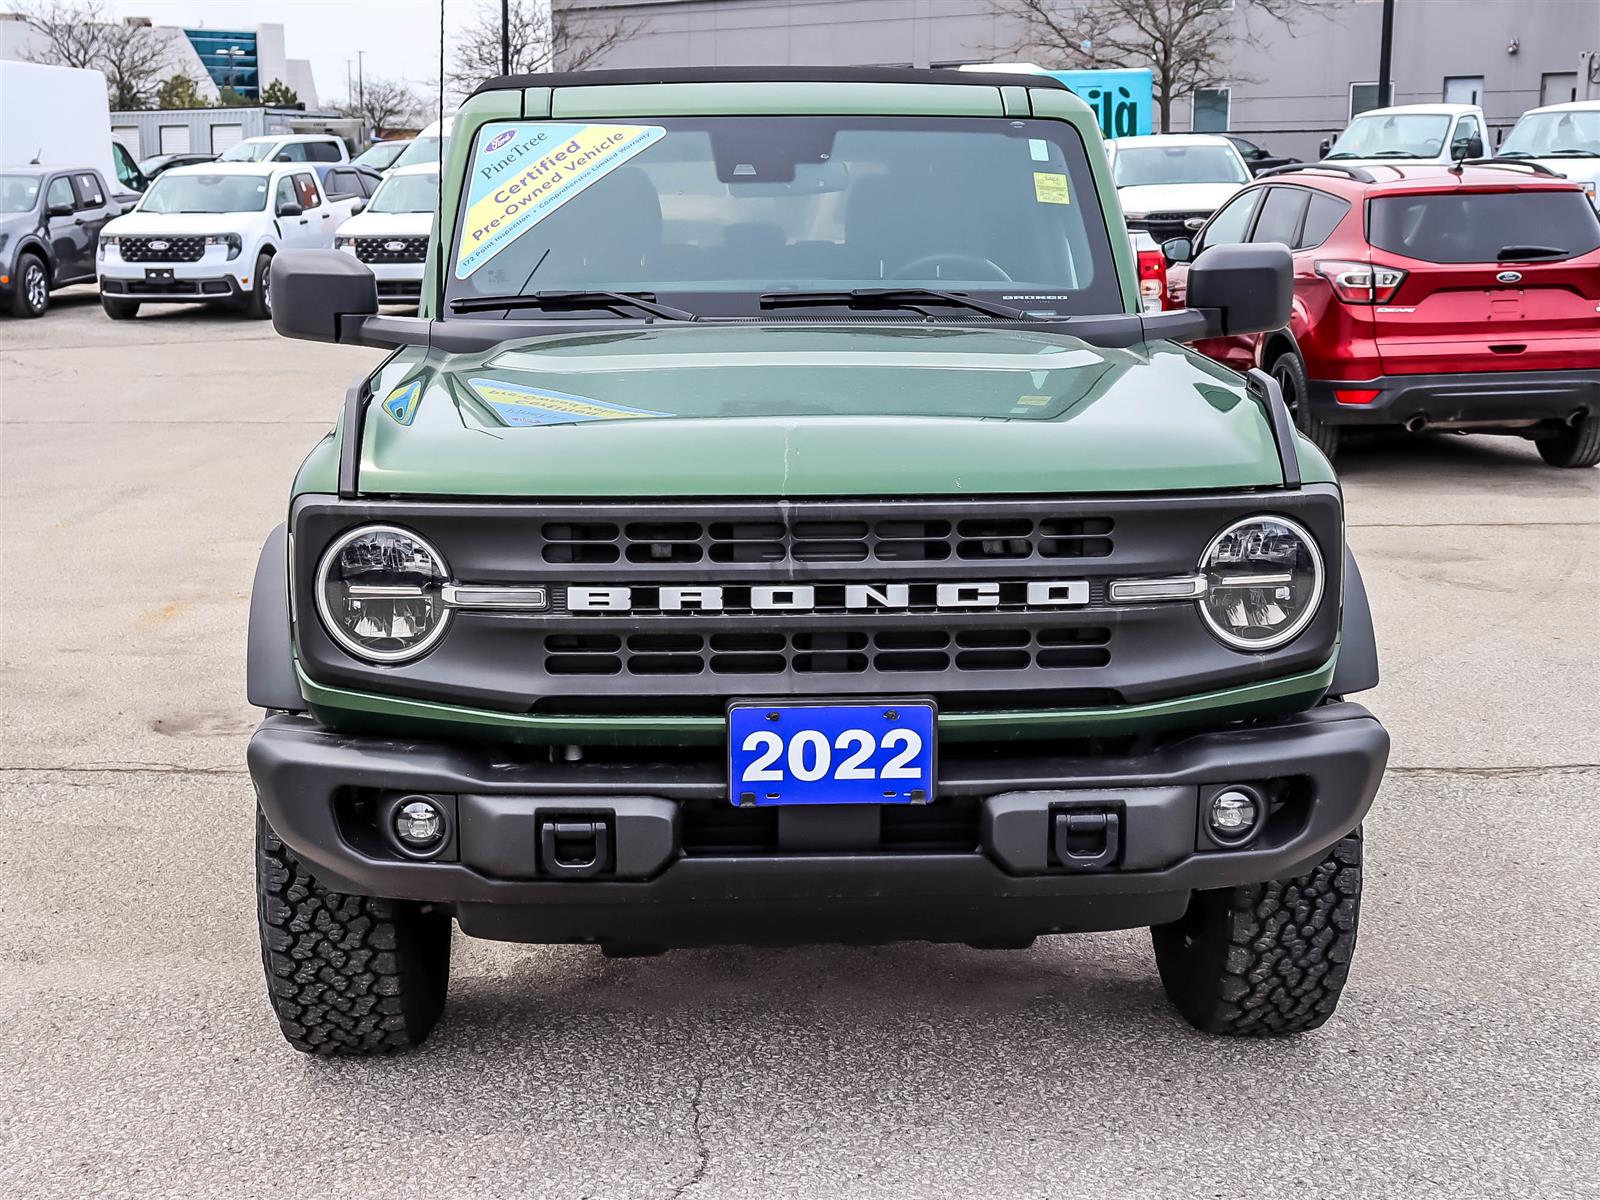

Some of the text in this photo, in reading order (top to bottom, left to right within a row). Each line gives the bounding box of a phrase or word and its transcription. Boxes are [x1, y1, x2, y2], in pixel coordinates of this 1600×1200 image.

[462, 131, 651, 267] 172 Point Inspection Comprehensive Limited Warranty
[472, 132, 624, 241] Pre-Owned Vehicle
[494, 140, 582, 204] Certified
[567, 580, 1091, 612] BRONCO
[741, 728, 923, 782] 2022
